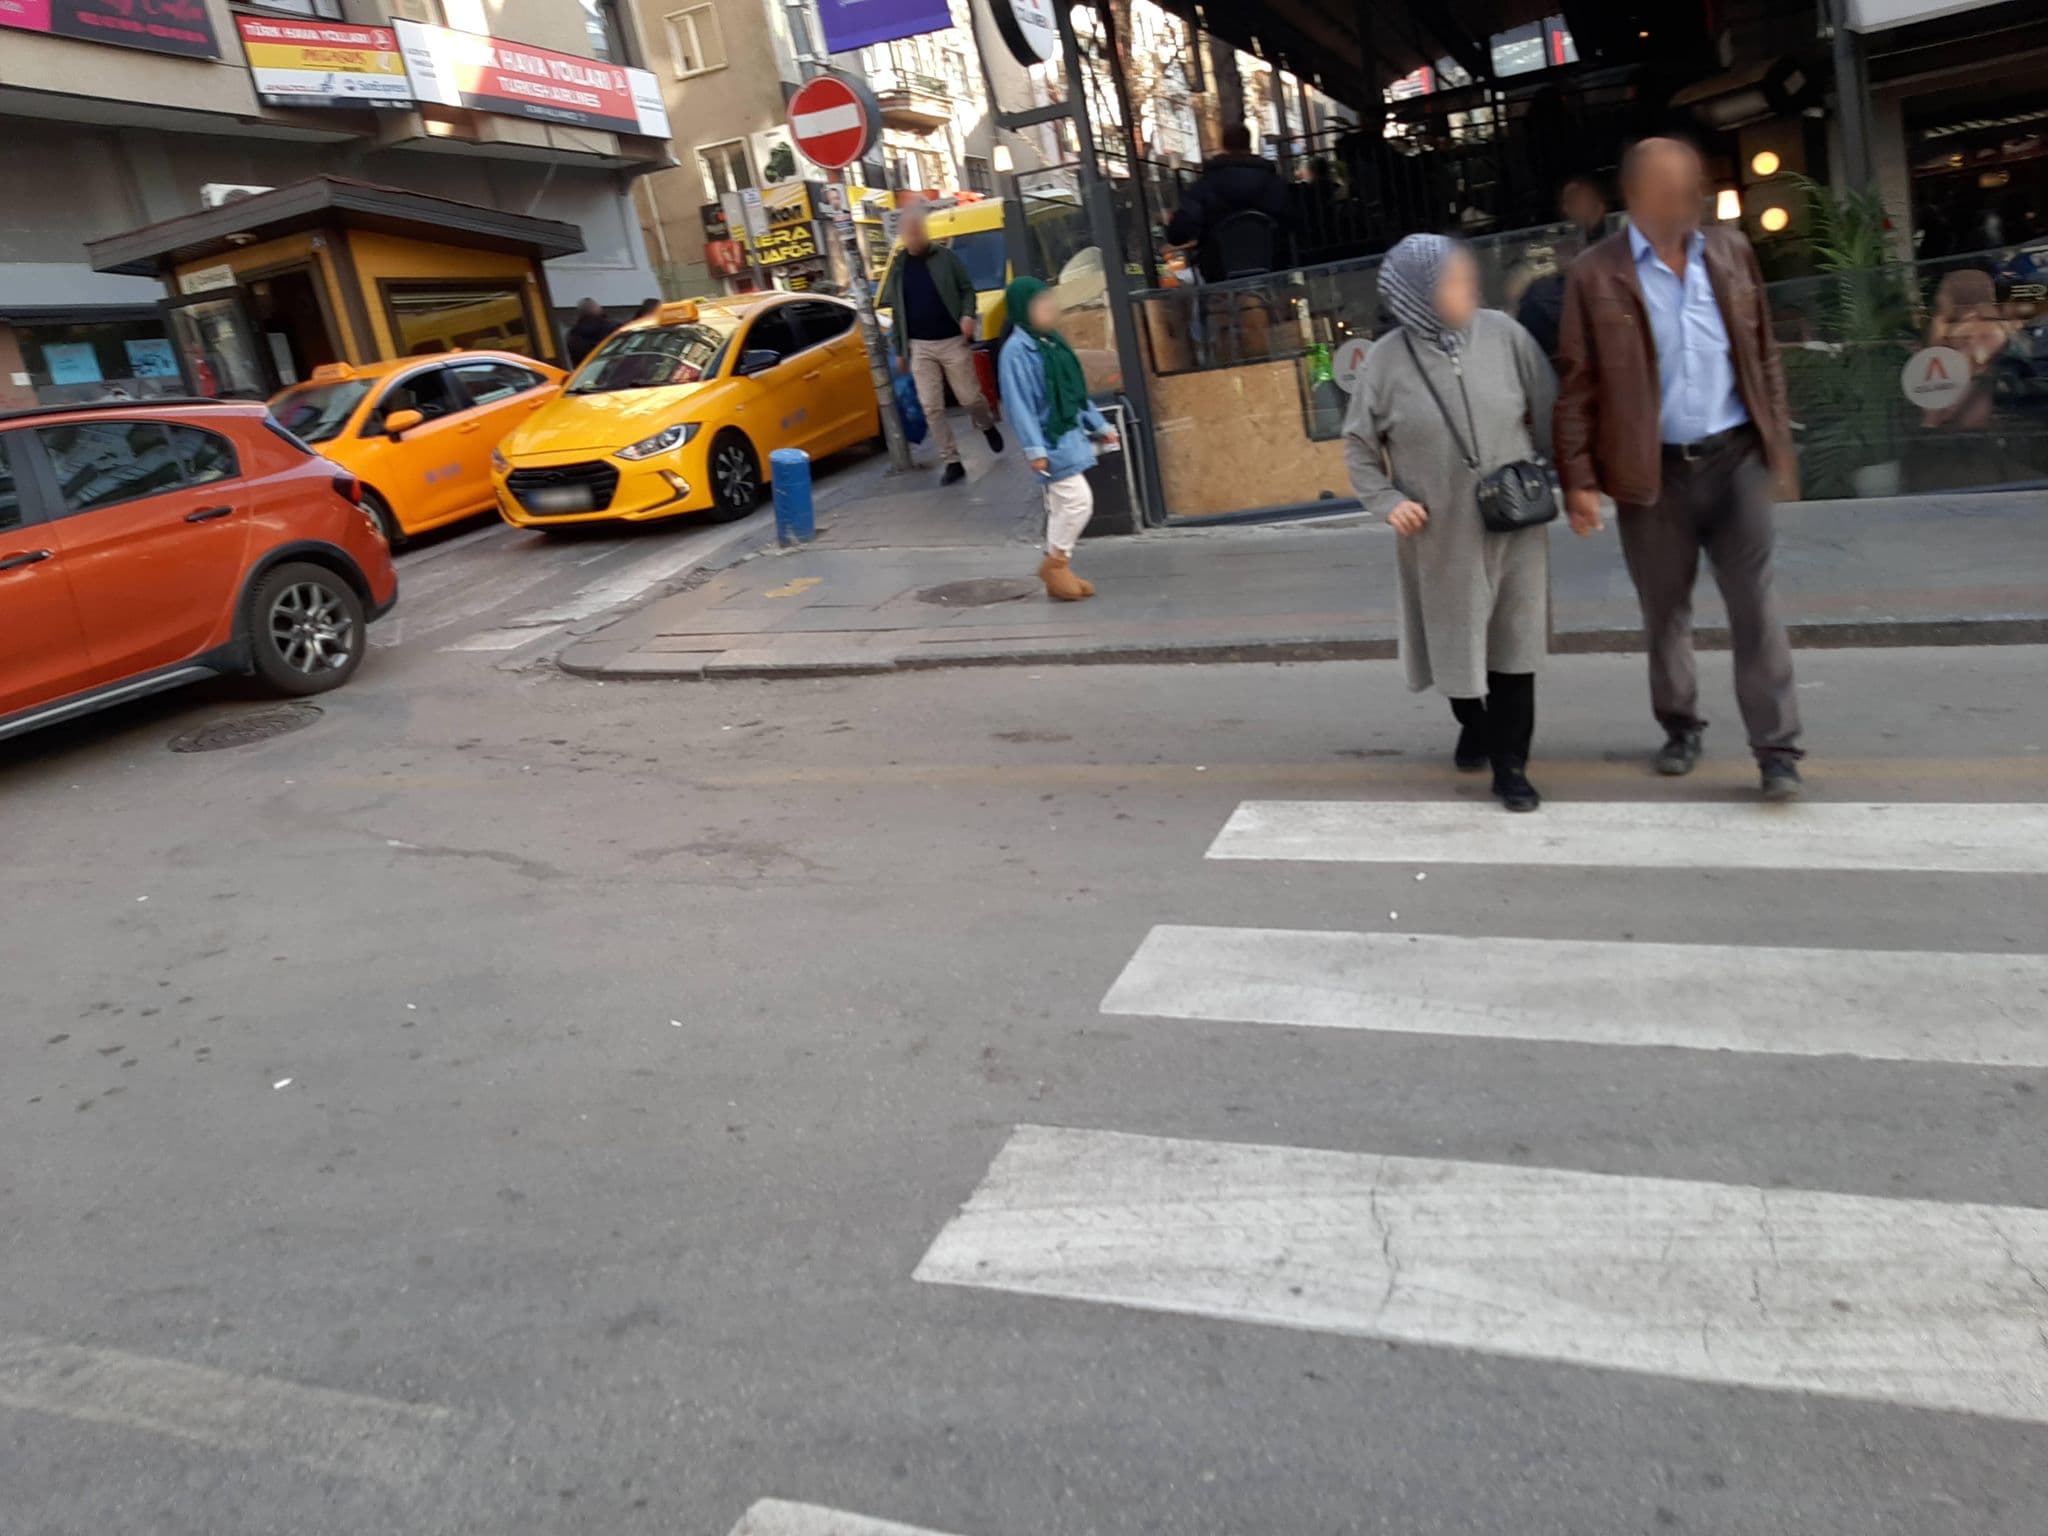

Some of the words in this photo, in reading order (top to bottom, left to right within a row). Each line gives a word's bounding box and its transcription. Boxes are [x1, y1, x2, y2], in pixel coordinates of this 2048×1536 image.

[242, 22, 282, 39] TÜRK
[283, 27, 321, 40] HAVA
[500, 50, 551, 78] HAVA
[548, 58, 612, 90] YOLLARI
